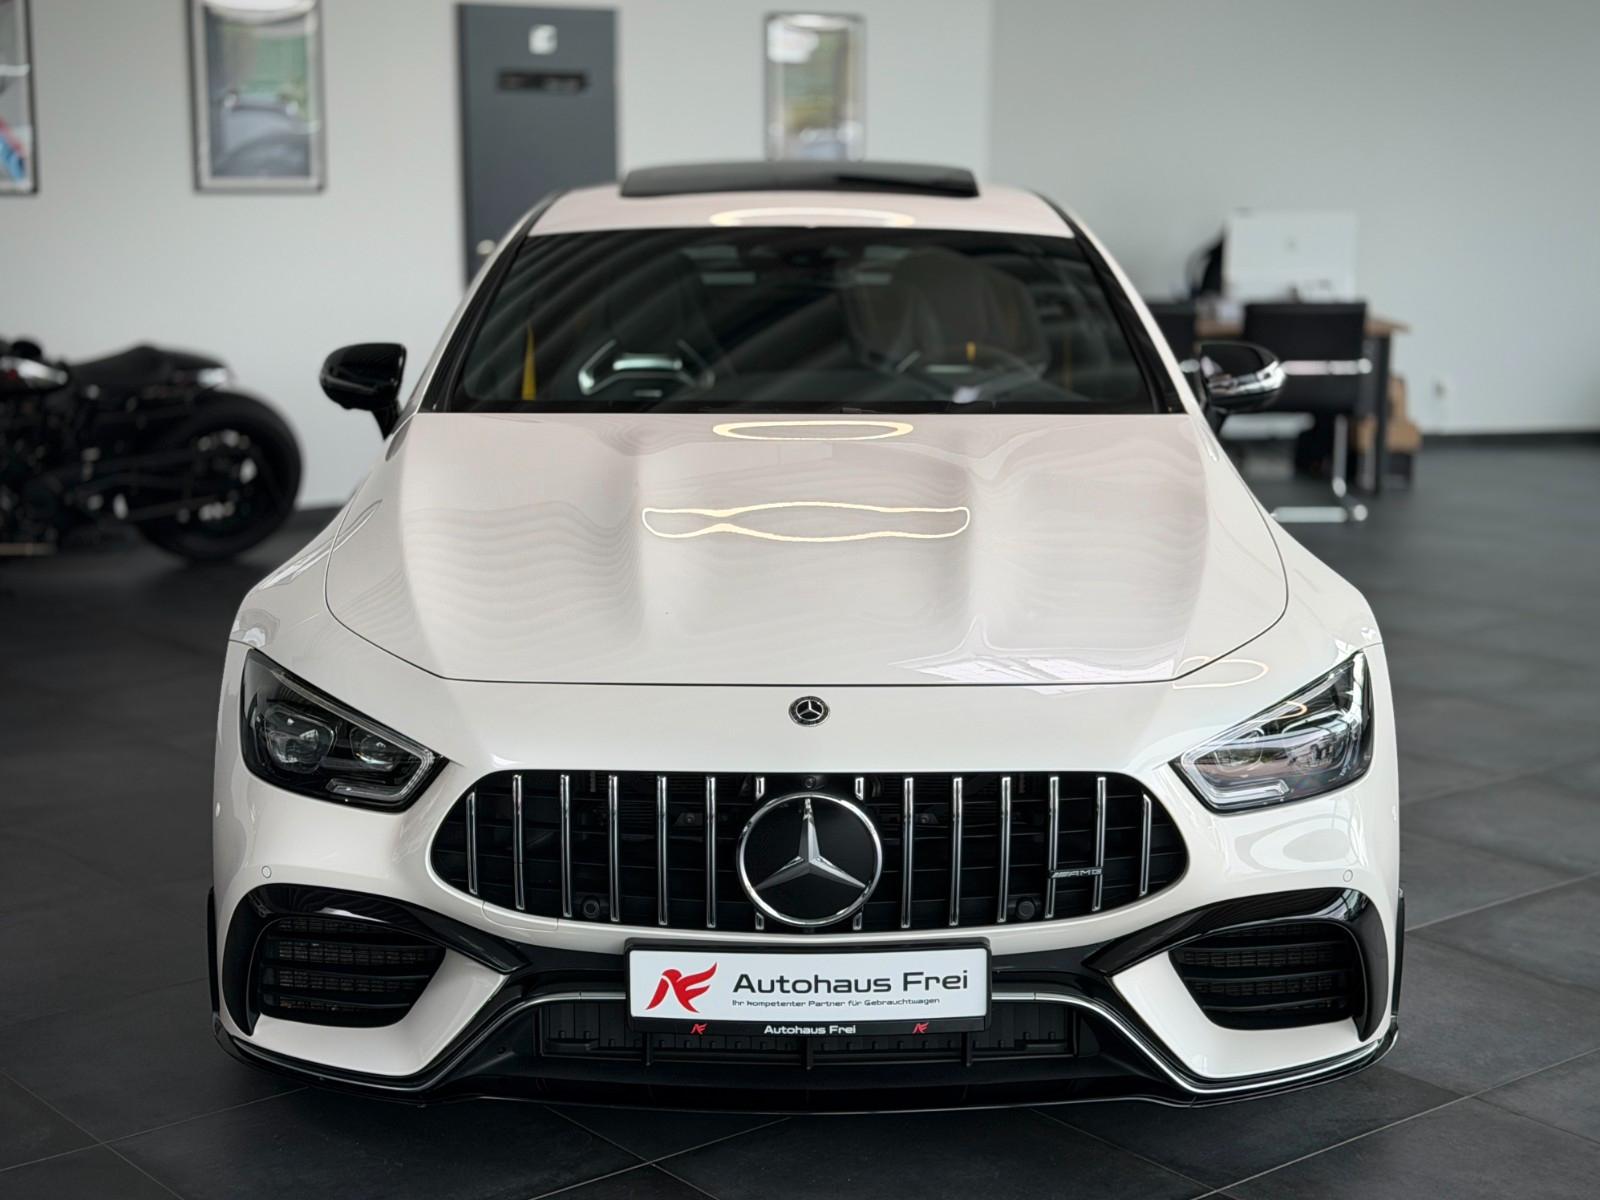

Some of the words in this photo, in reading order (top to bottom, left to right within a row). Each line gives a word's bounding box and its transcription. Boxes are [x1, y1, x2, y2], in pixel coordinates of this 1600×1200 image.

[732, 973, 892, 994] Autohaus
[902, 969, 968, 992] Frei
[731, 999, 745, 1007] Ihr
[746, 999, 806, 1008] kompetenter
[847, 999, 864, 1007] für
[864, 997, 940, 1006] Gebrauchtwagen
[763, 1024, 827, 1035] Autohaus
[828, 1024, 857, 1035] Frei
